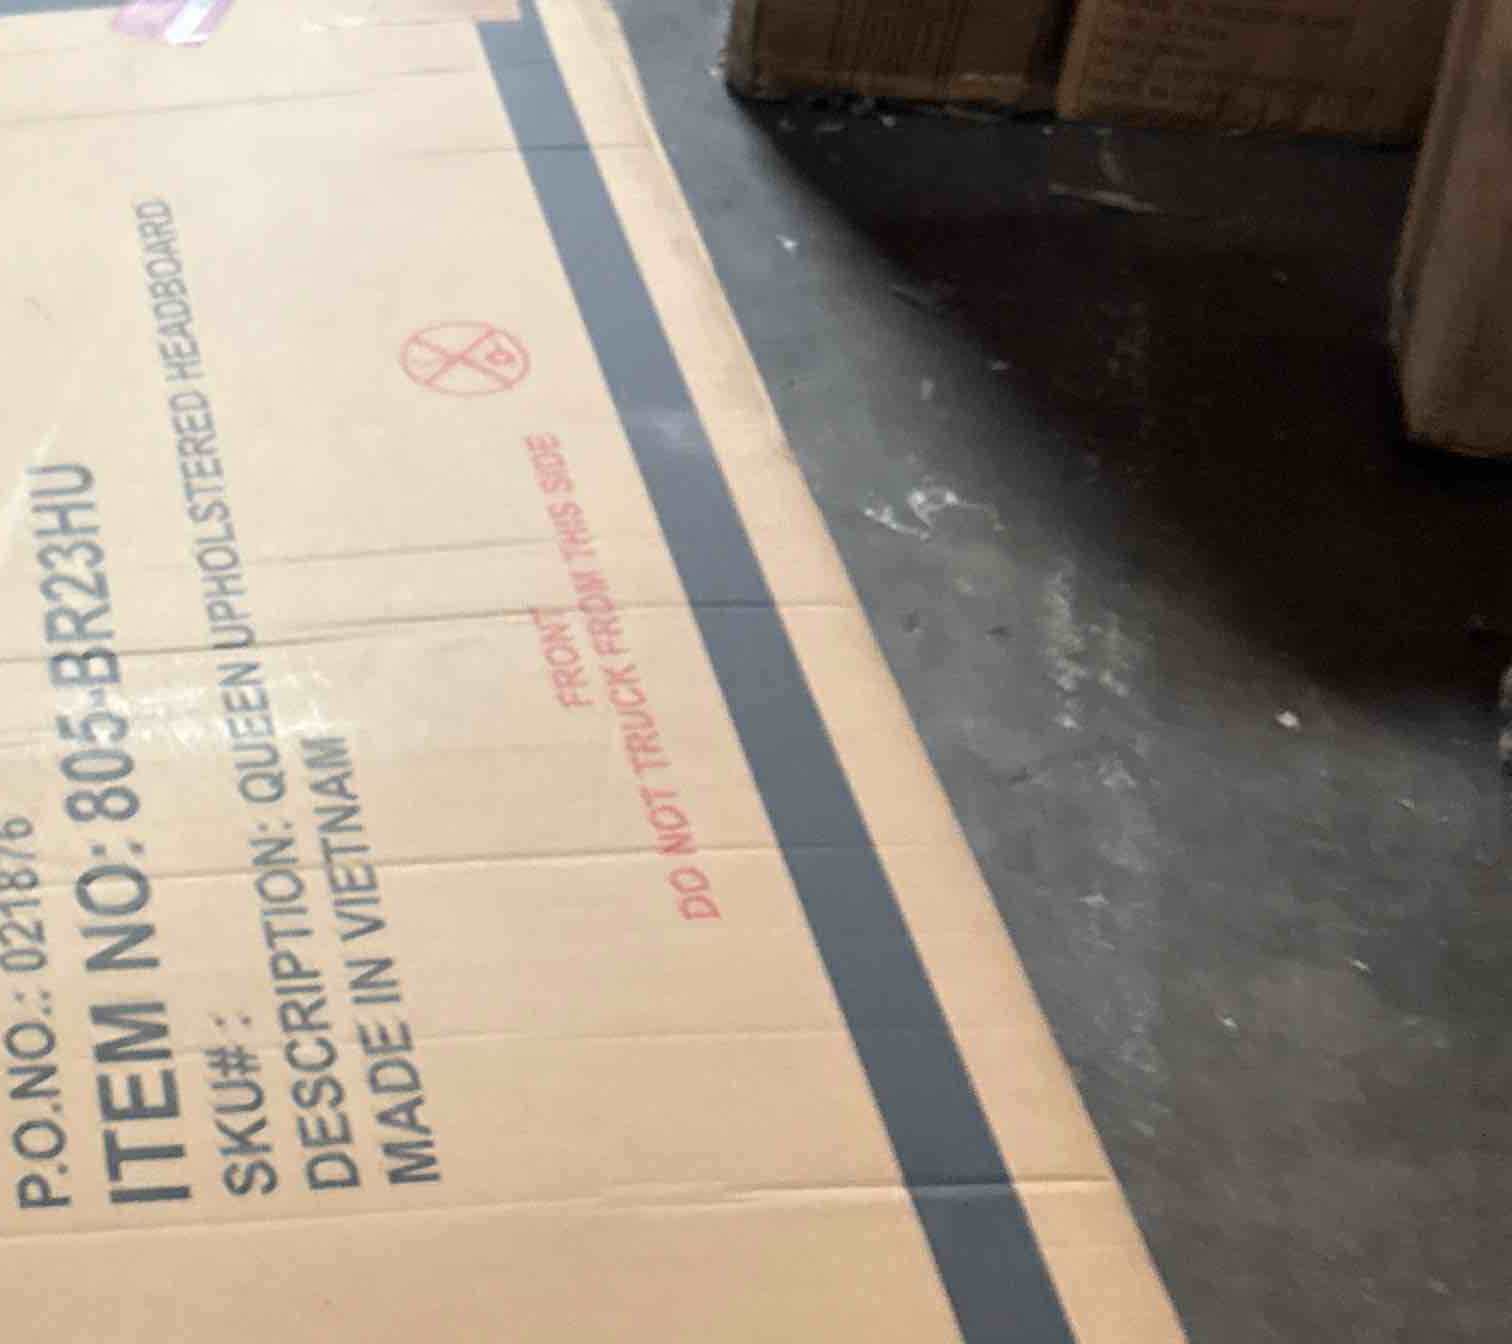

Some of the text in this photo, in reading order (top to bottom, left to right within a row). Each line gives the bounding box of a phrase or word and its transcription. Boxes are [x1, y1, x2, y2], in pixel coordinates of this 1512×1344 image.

[26, 461, 192, 1205] ITEM NO: 805-BR23HU
[133, 197, 361, 1193] DESCRIPTION: QUEEN UPHOLSTERED HEADBOARD
[524, 431, 722, 922] DO NOT TRUCK FROM THIS SIDE
[529, 606, 594, 713] FRONT
[300, 735, 442, 1188] MADE IN VIETNAM
